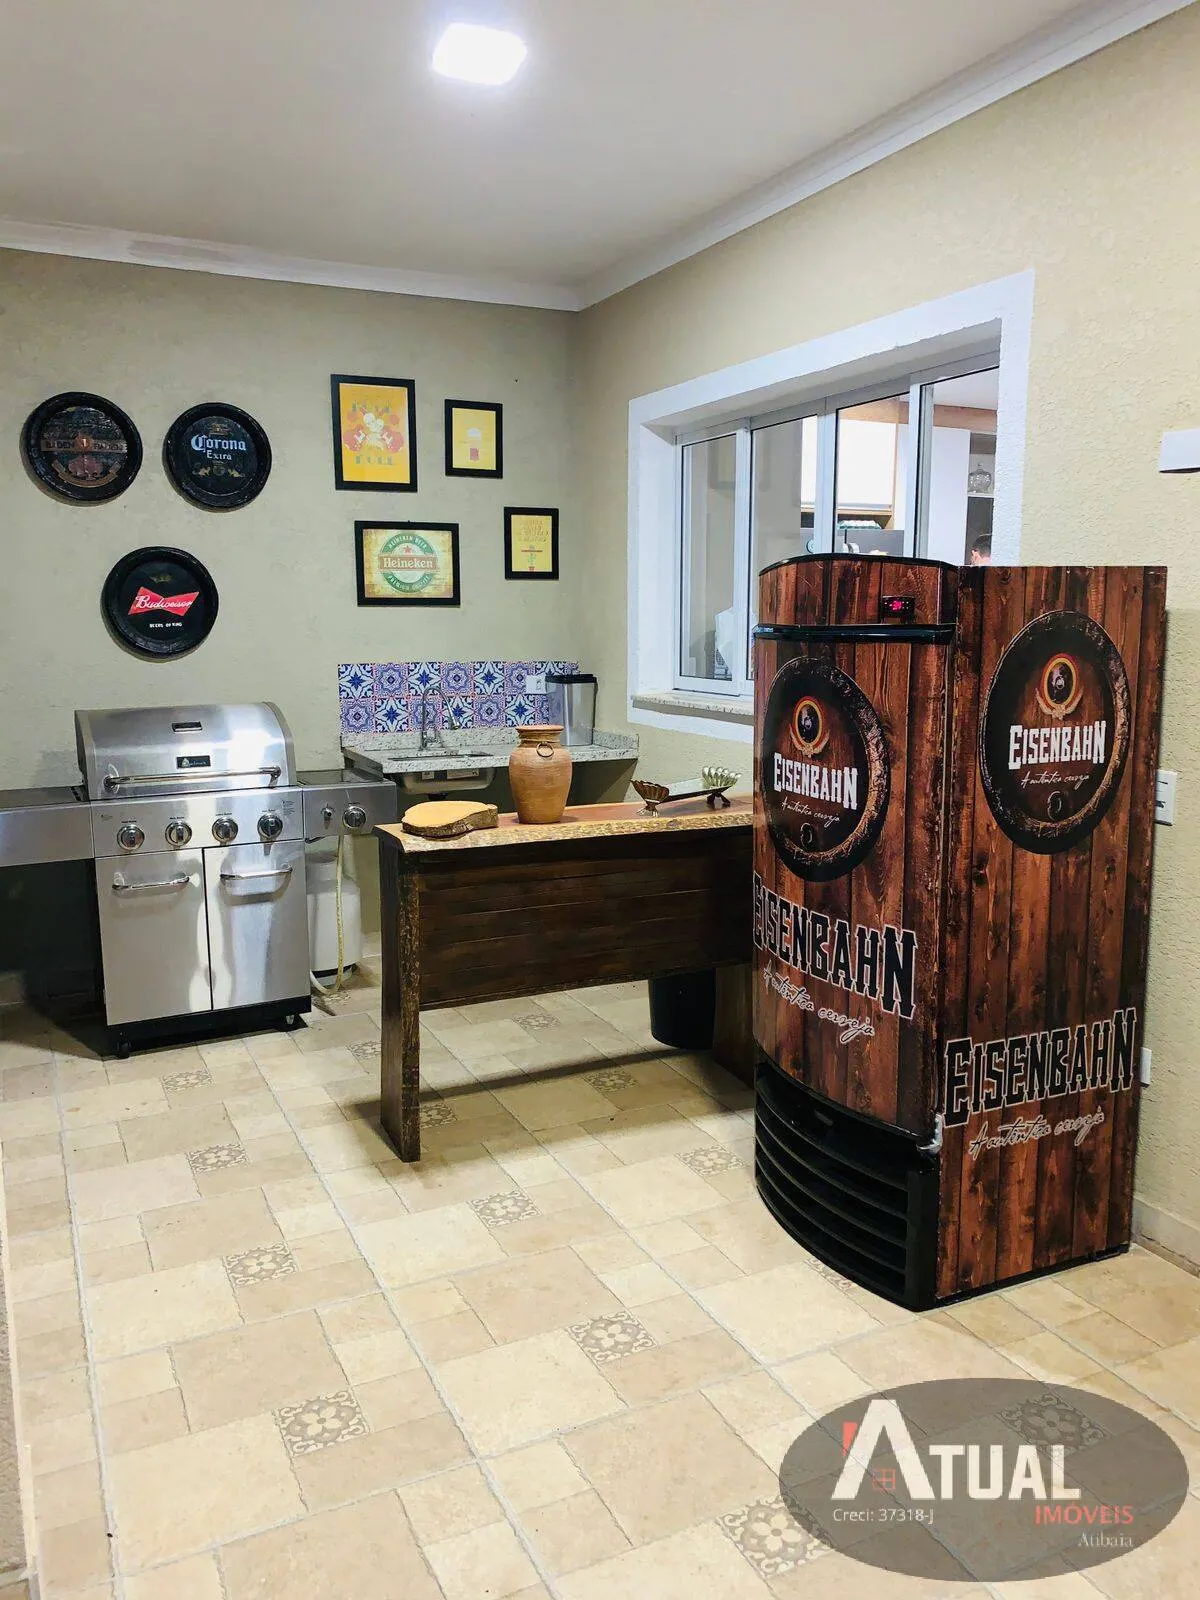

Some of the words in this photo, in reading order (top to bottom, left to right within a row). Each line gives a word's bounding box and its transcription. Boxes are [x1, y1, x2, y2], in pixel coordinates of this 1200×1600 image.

[190, 434, 247, 453] Corona
[206, 450, 232, 460] Extra
[383, 557, 433, 569] Heineken
[135, 595, 194, 609] Budweiser
[1008, 719, 1106, 770] EISENBAHN
[773, 752, 858, 810] EISENBAHN
[752, 871, 918, 1020] EISENBAHN
[818, 1008, 875, 1044] cerveja
[943, 1007, 1137, 1129] EISENBAHN
